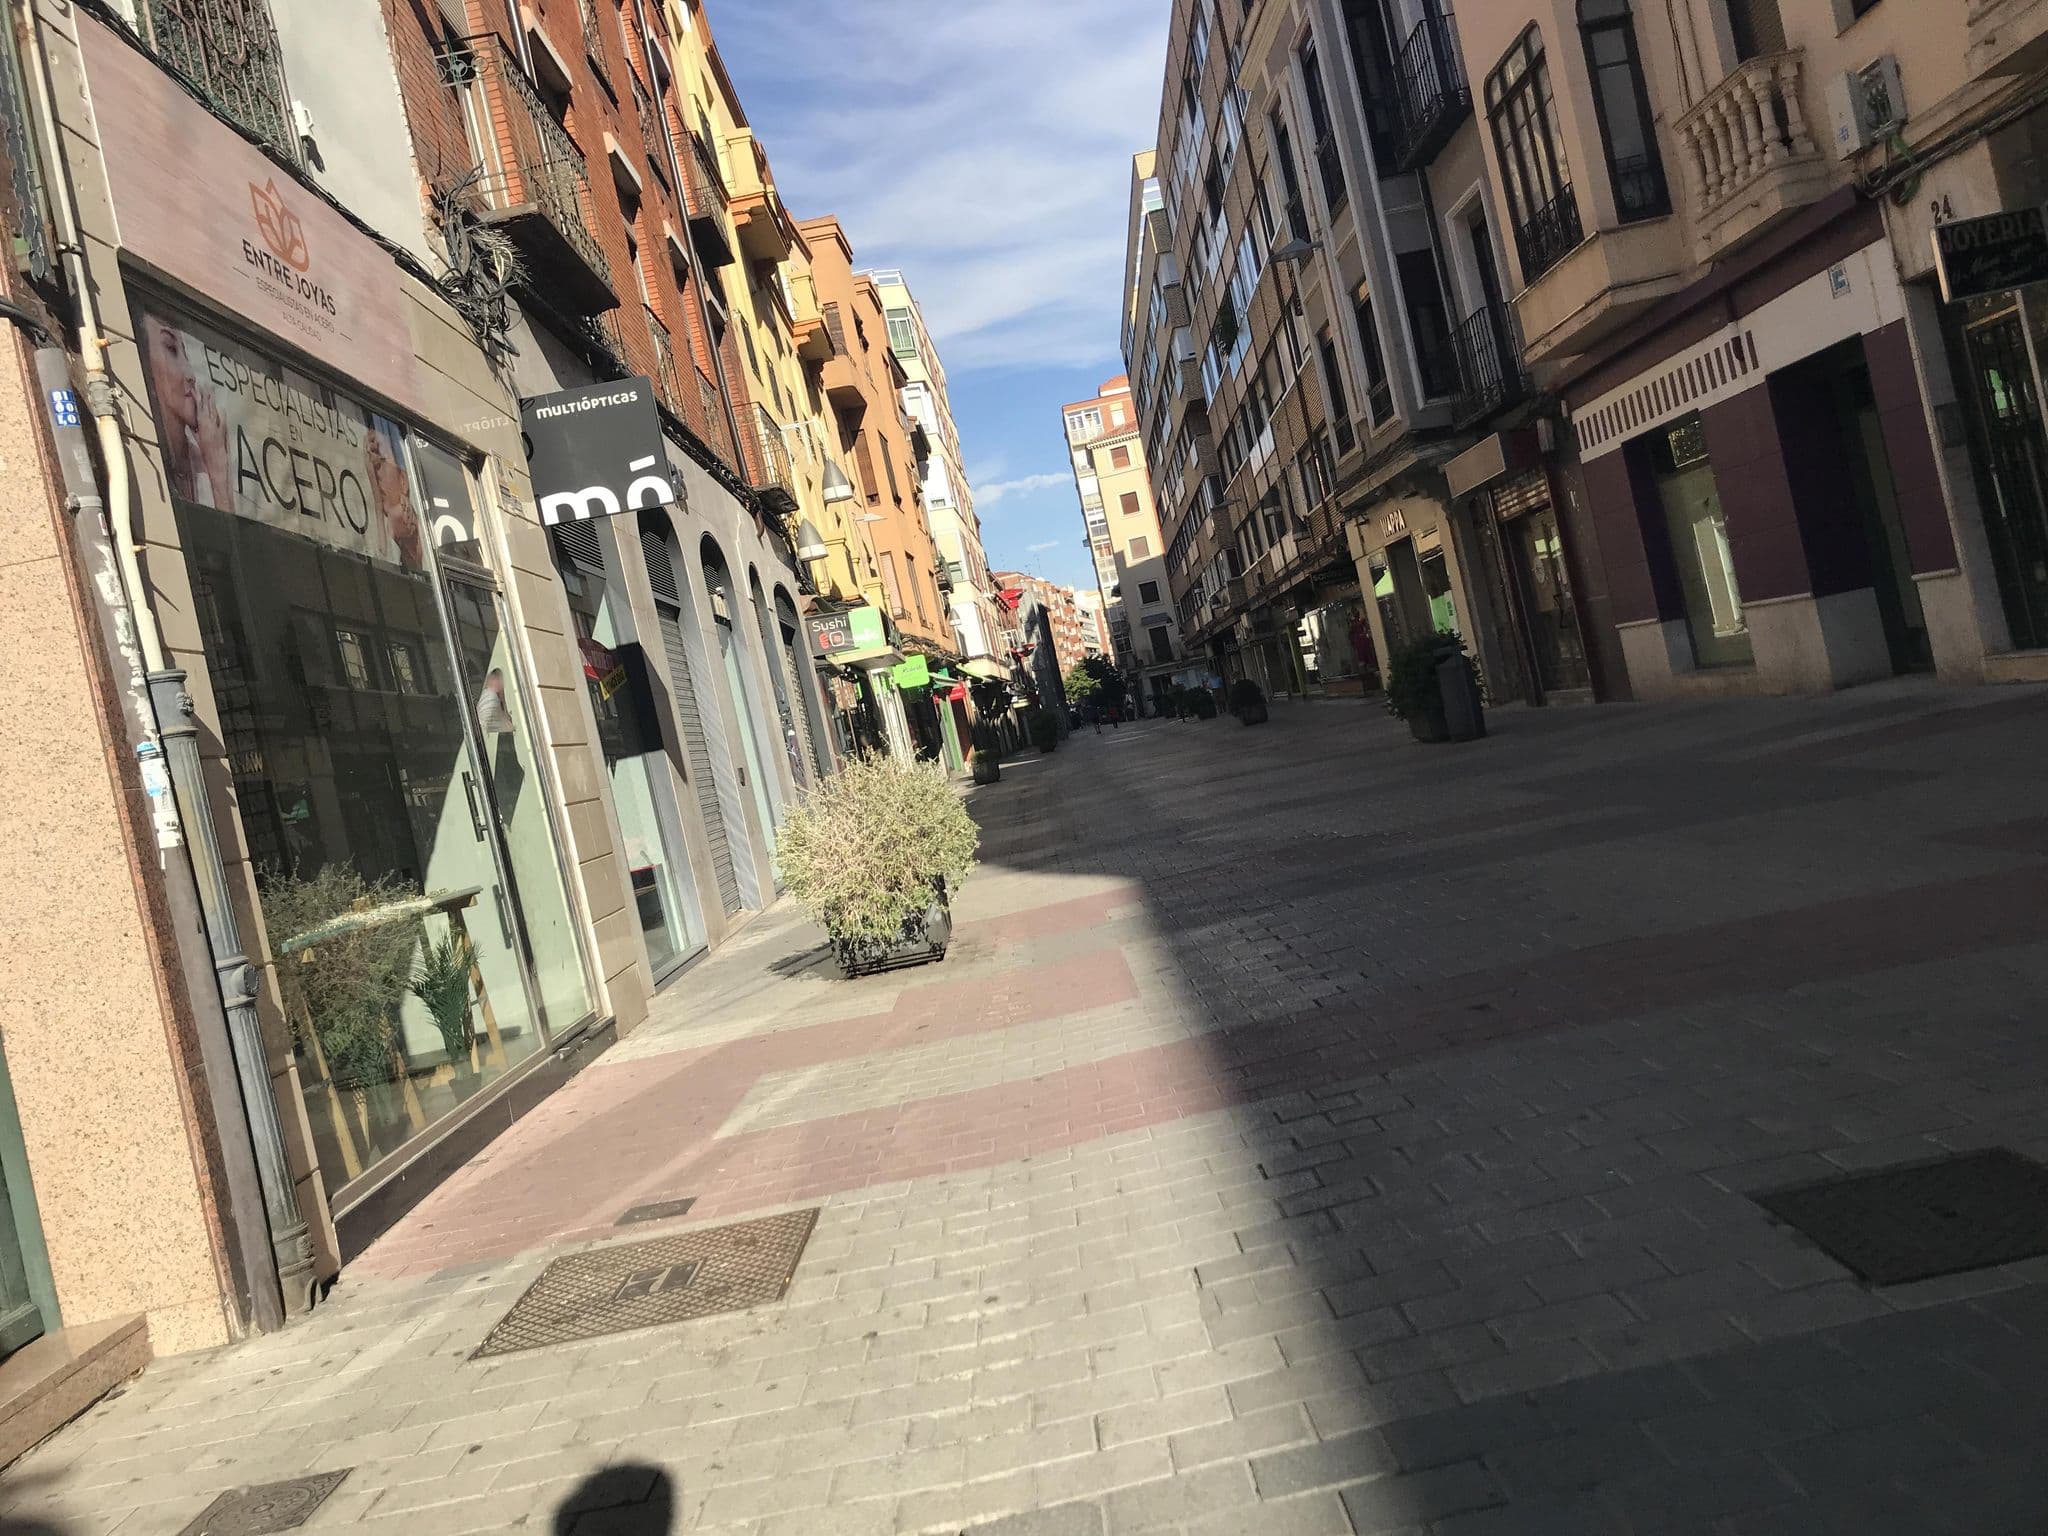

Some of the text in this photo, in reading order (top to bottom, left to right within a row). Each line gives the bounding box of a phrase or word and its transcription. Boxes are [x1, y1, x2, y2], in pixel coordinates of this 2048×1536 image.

[1930, 194, 1954, 225] 24
[242, 239, 336, 316] ENTRE JOYAS
[204, 346, 358, 448] ESPECIALISTAS
[289, 423, 303, 442] EN
[237, 424, 368, 535] ACERO
[811, 616, 847, 633] Sushi
